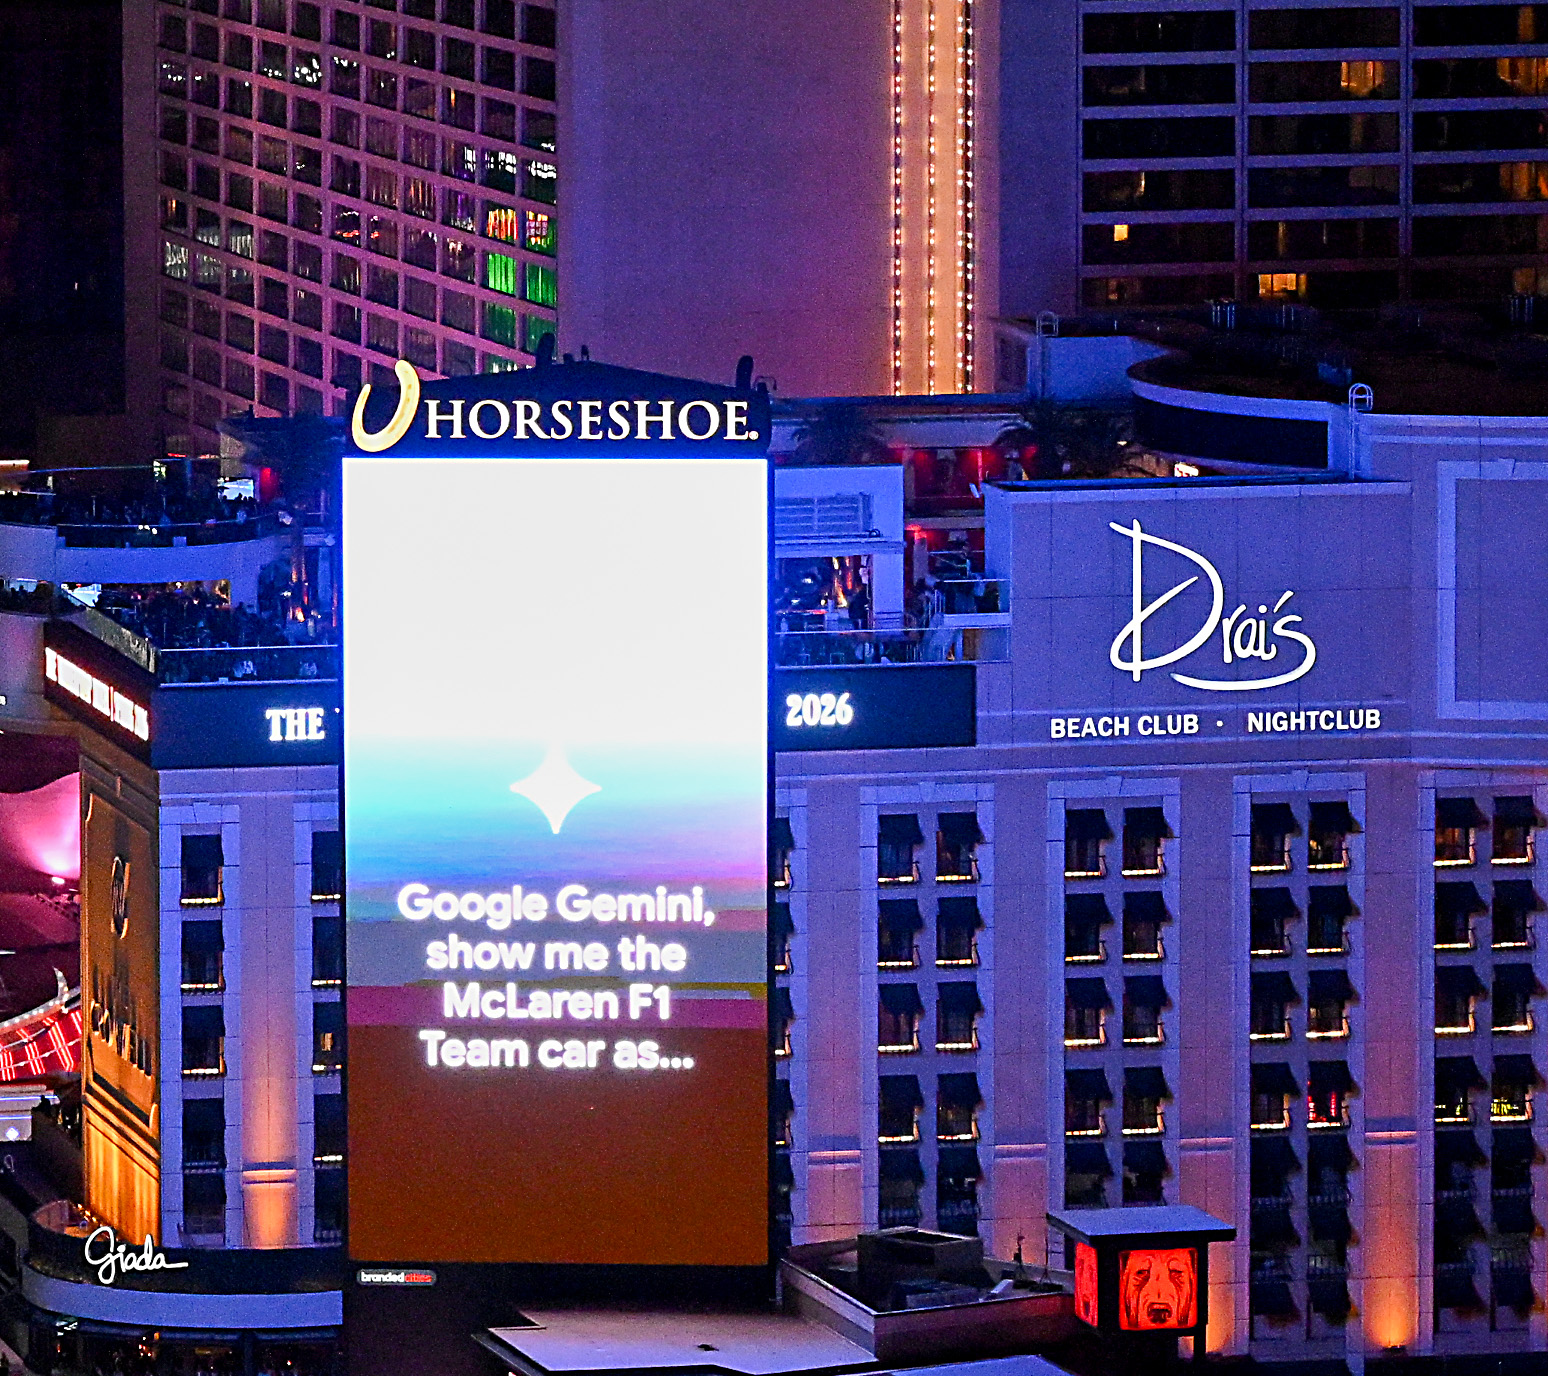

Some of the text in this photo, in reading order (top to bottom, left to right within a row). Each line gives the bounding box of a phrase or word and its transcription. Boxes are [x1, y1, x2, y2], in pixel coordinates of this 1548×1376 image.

[1108, 519, 1316, 691] Drai's
[265, 707, 326, 742] THE
[784, 691, 854, 728] 2026
[1050, 708, 1382, 740] BEACH CLUB NIGHTCLUB
[397, 883, 716, 930] Google Gemini,
[425, 935, 688, 972] show me the
[442, 982, 673, 1021] McLaren F1
[418, 1029, 695, 1070] Team car as...
[85, 1226, 189, 1285] Giada
